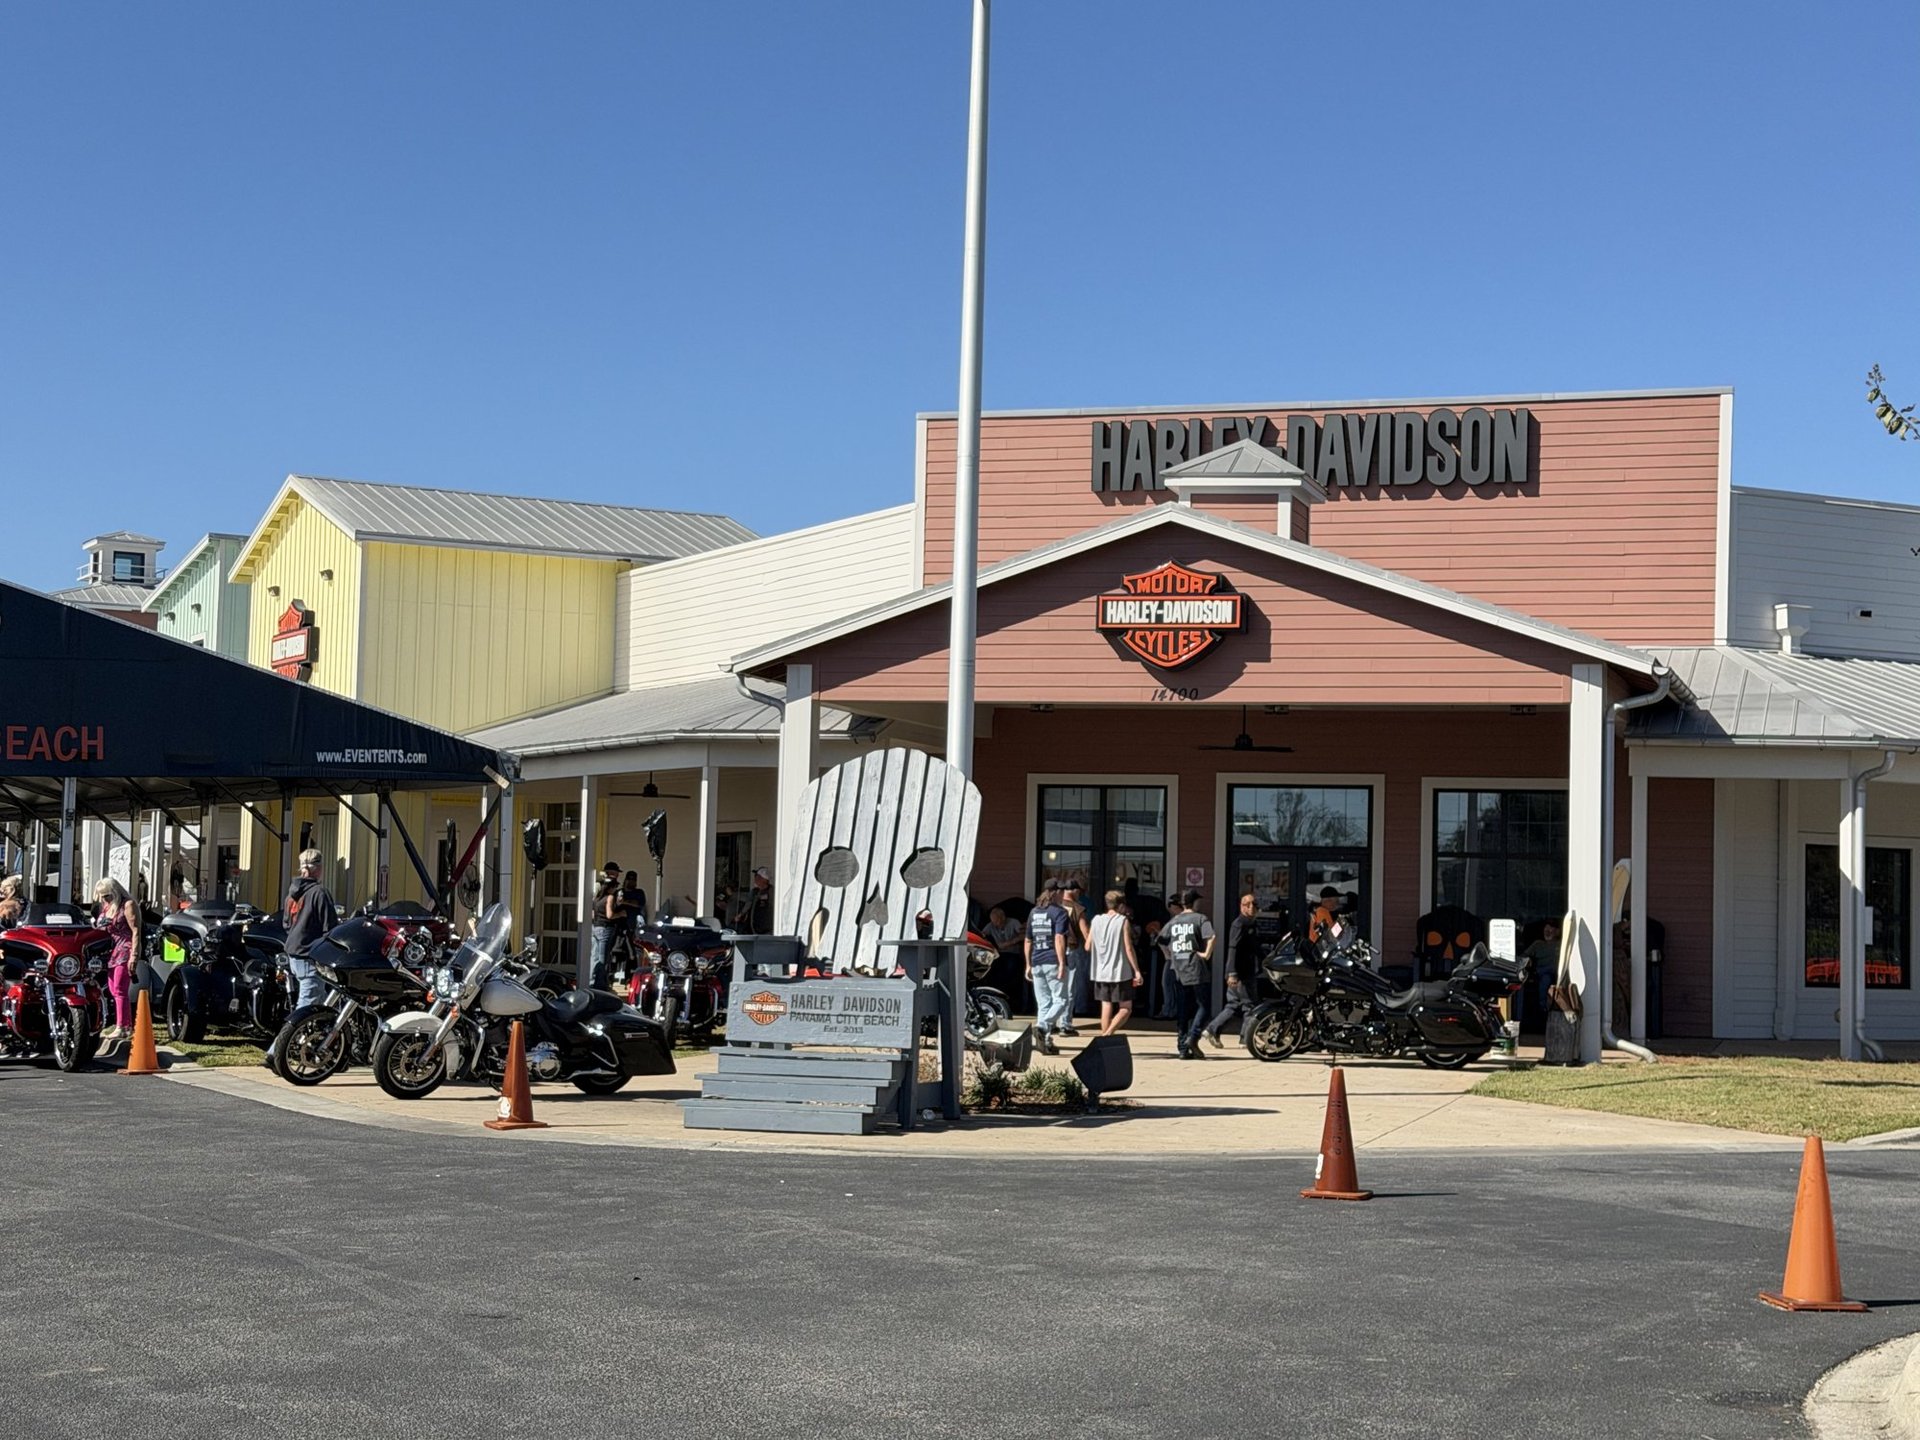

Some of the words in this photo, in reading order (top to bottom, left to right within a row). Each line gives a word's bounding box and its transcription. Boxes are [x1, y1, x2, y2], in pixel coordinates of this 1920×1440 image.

[1137, 568, 1203, 593] MOTOR
[1106, 600, 1233, 624] HARLEY-DAVIDSON
[1135, 631, 1202, 661] CYCLES
[1151, 688, 1199, 701] 14700
[0, 726, 104, 761] EACH
[316, 749, 427, 763] www.EVENTENTS.com
[790, 994, 834, 1010] HARLEY
[843, 996, 901, 1013] DAVIDSON
[789, 1011, 831, 1024] PANAMA
[836, 1013, 860, 1025] CITY
[863, 1015, 900, 1027] BEACH
